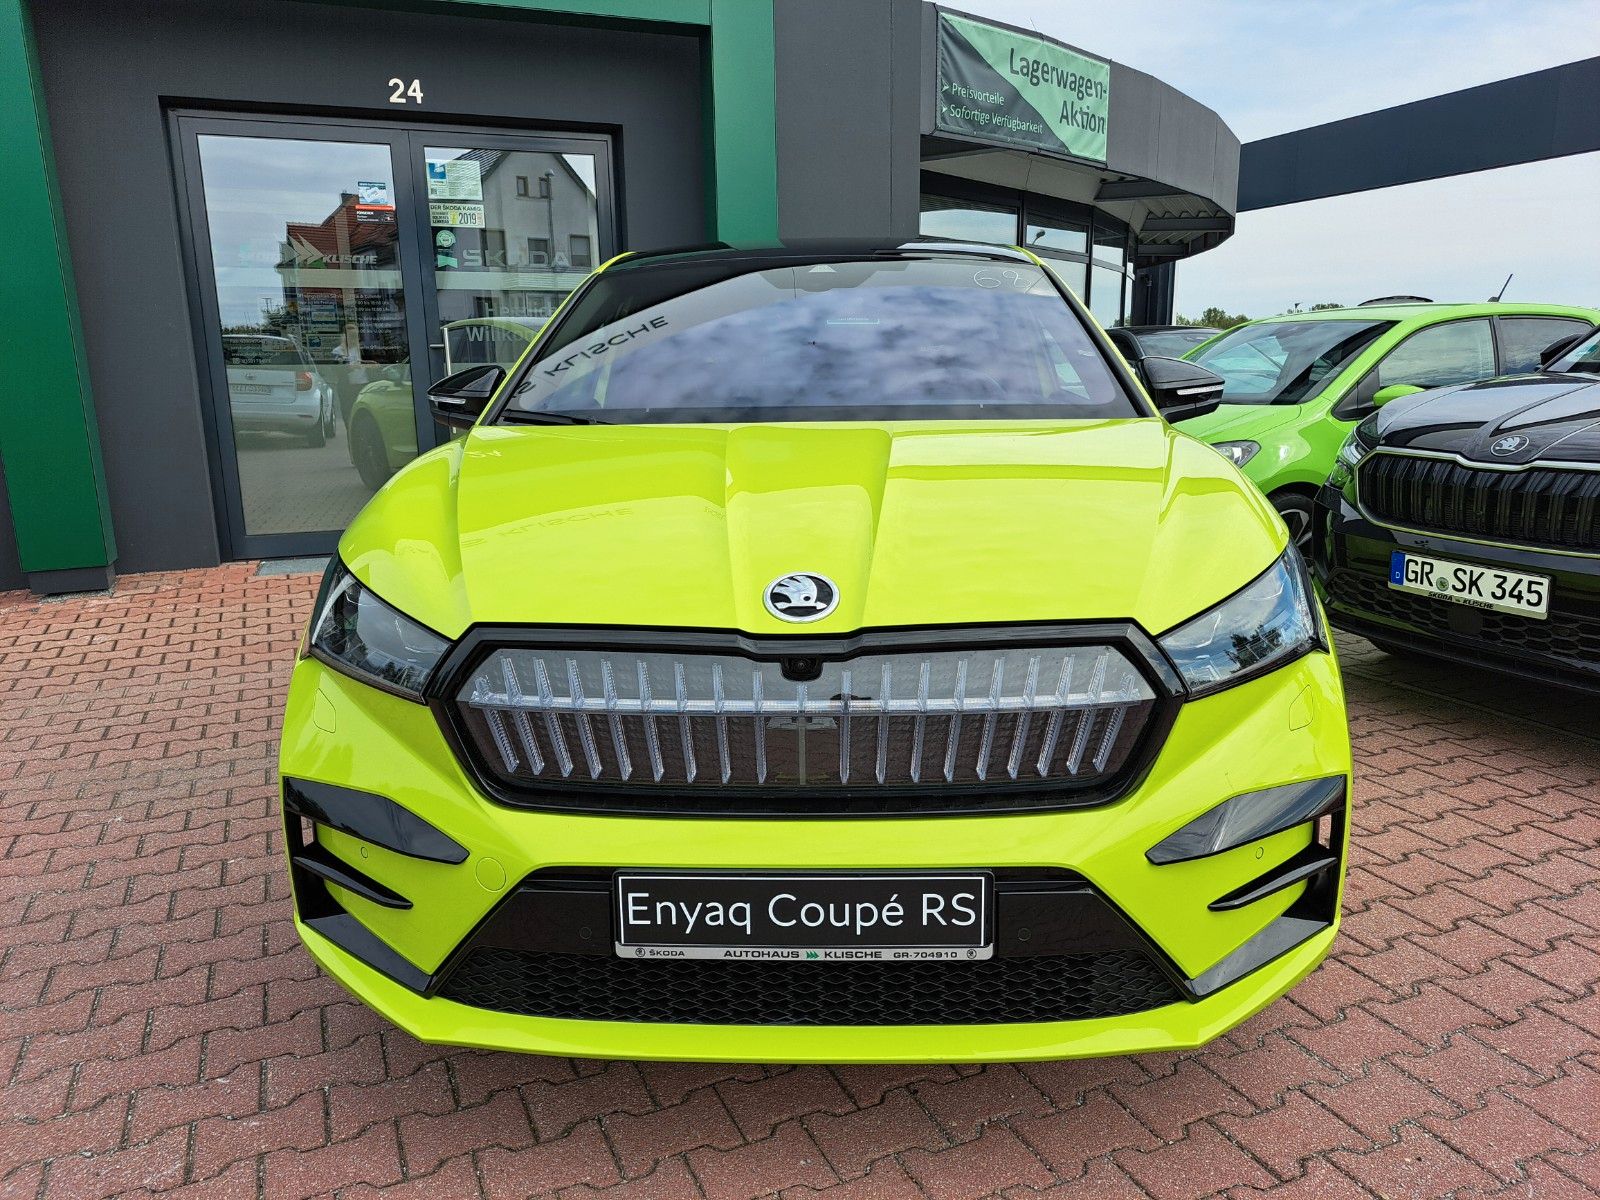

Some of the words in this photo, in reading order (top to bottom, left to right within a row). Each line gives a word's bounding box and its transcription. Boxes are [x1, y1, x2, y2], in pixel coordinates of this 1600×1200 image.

[1009, 48, 1107, 100] Lagerwagen-
[388, 78, 424, 104] 24
[952, 82, 1005, 106] Preisvorteile
[949, 104, 991, 126] Sofortige
[991, 112, 1044, 135] Verfügbarkeit
[1059, 100, 1106, 135] Aktion
[458, 212, 477, 225] 2019
[322, 254, 378, 265] KLISCHE
[1395, 571, 1400, 579] D
[1405, 558, 1434, 587] GR
[1452, 568, 1485, 597] SK
[1491, 574, 1543, 606] 345
[627, 892, 752, 935] Enyaq
[768, 893, 904, 936] Coupé
[922, 893, 977, 926] RS
[649, 948, 685, 957] ŠKODA
[723, 949, 800, 959] AUTOHAUS
[824, 951, 882, 959] KLISCHE
[893, 951, 958, 959] GR-704910
